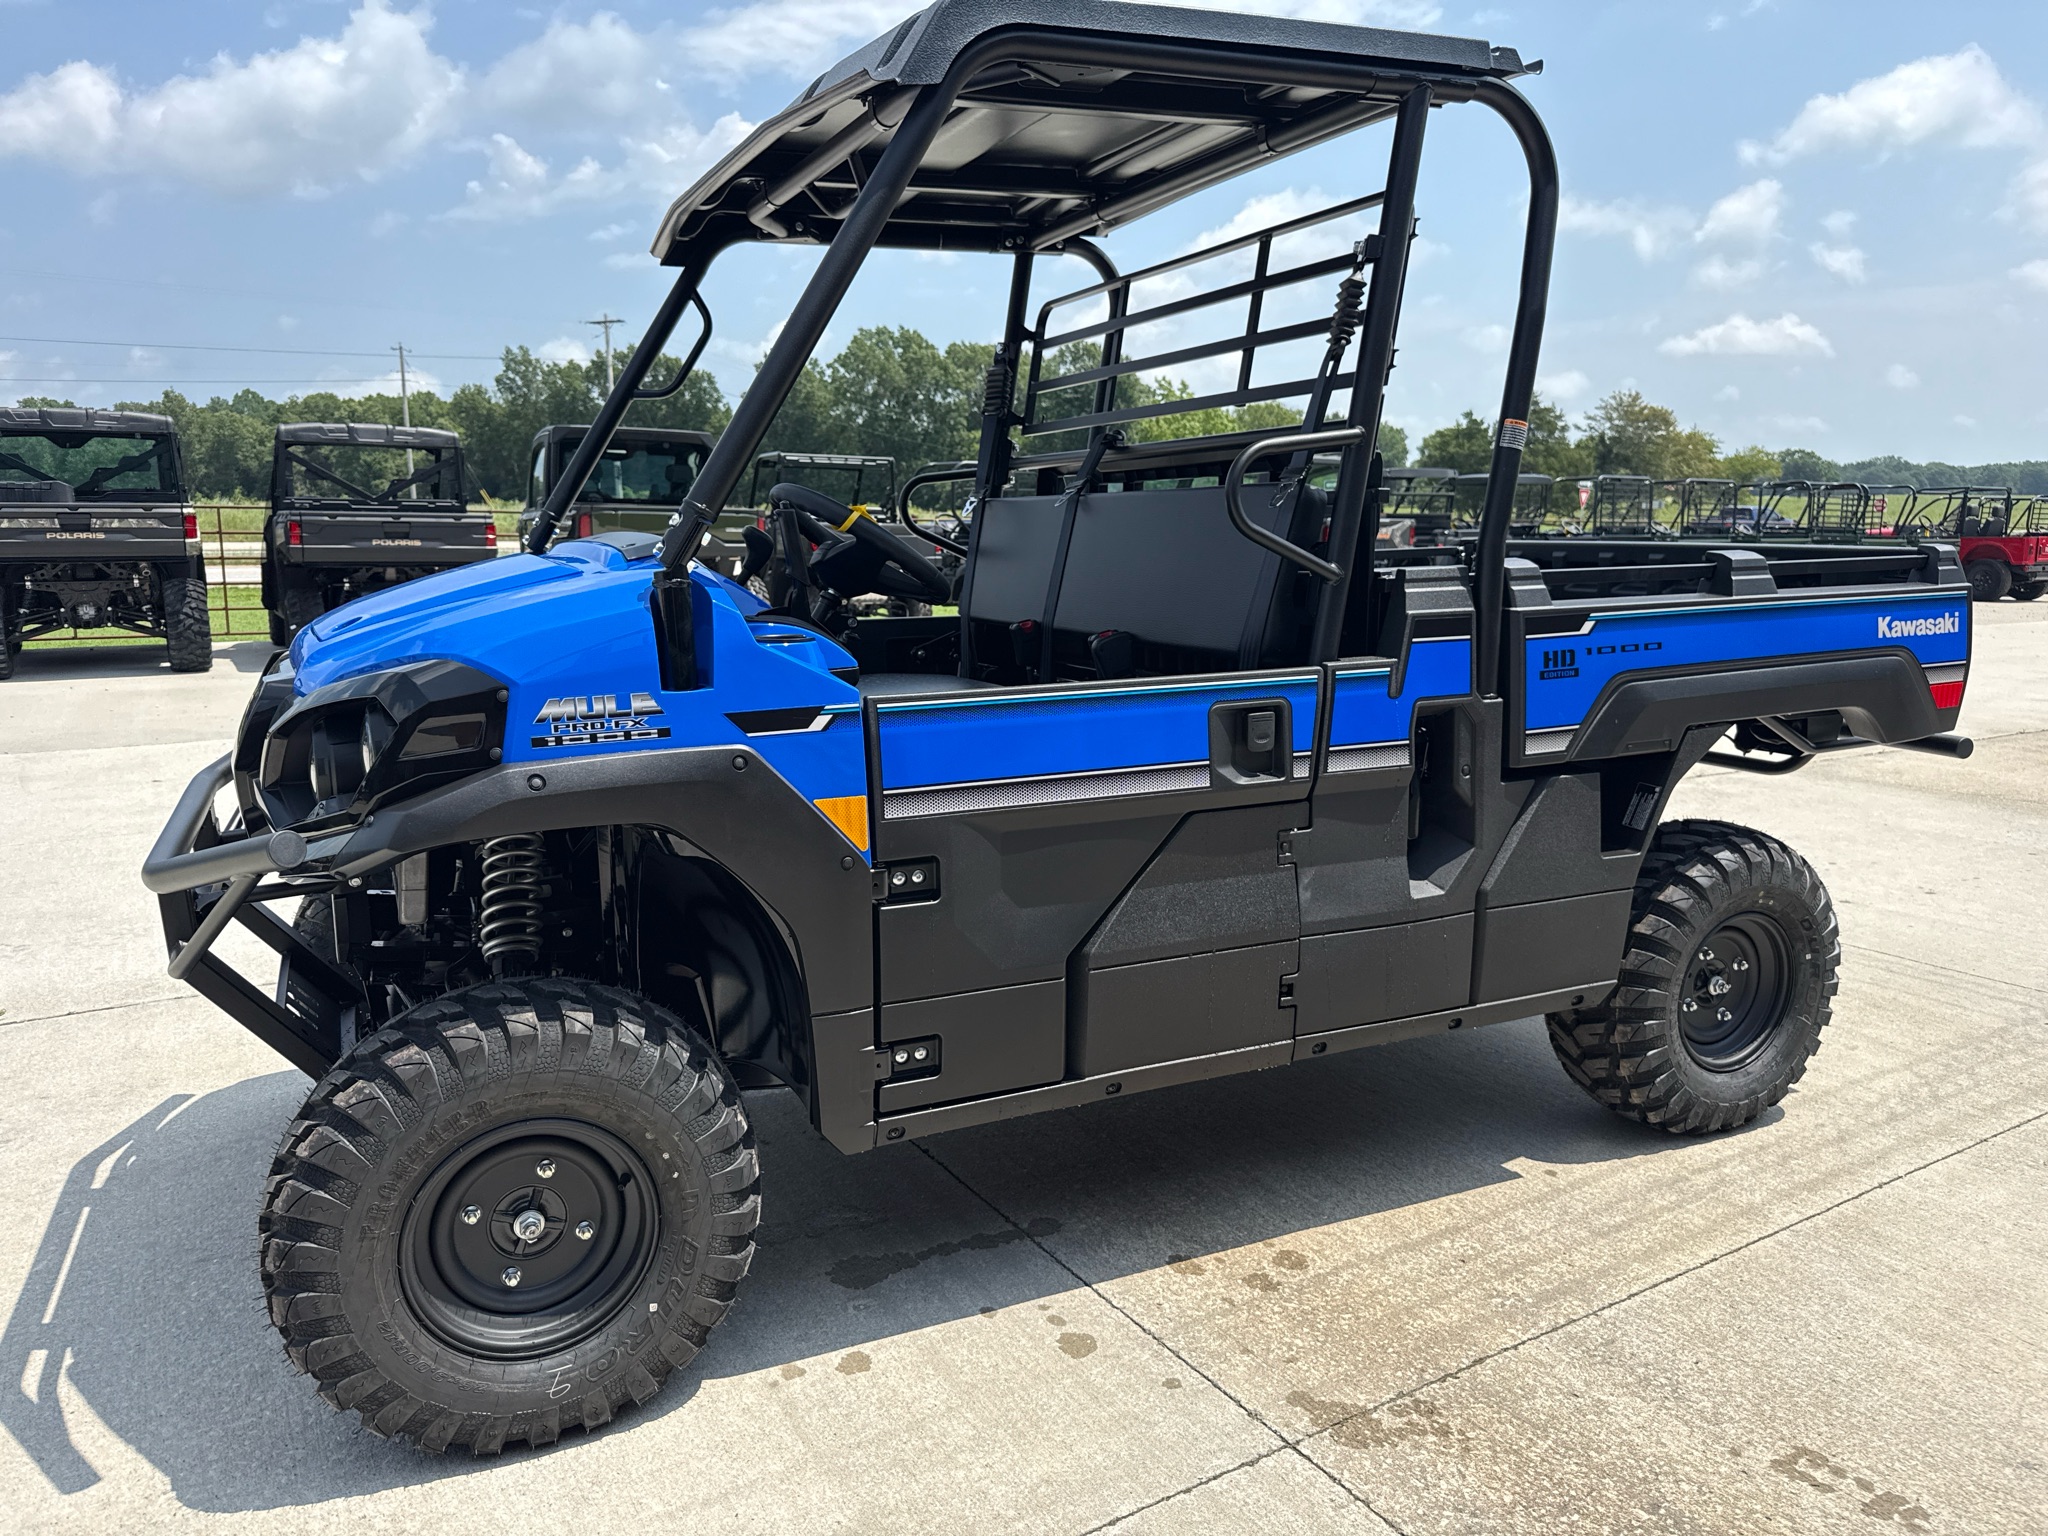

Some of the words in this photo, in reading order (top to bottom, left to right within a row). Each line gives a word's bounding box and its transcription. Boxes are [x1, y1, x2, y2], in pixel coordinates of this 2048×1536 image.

[1877, 611, 1959, 638] Kawasaki
[1543, 649, 1576, 668] HD
[1585, 642, 1662, 656] 1000
[1543, 669, 1576, 679] EDITION
[533, 692, 667, 724] MULE
[545, 729, 659, 746] 1000
[551, 716, 649, 734] PRO-FX
[1801, 918, 1820, 1006] DURO
[586, 1234, 700, 1383] DURO
